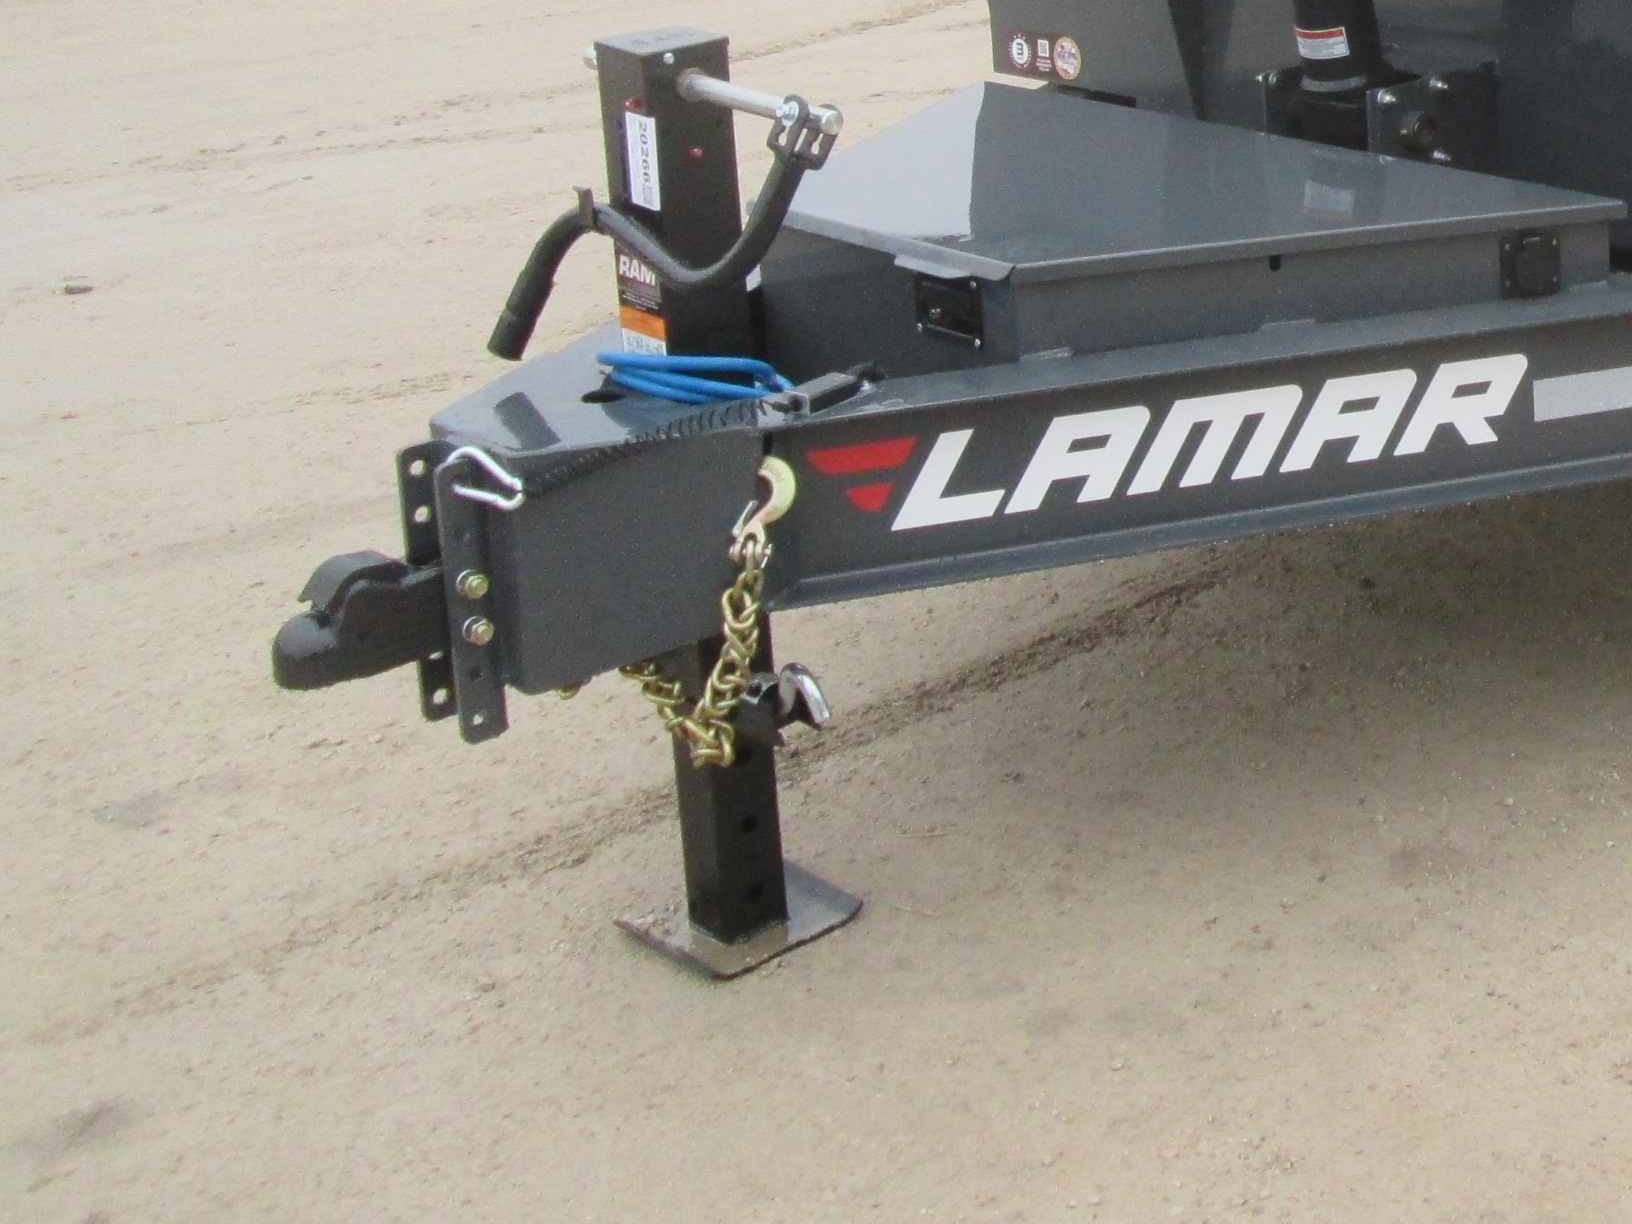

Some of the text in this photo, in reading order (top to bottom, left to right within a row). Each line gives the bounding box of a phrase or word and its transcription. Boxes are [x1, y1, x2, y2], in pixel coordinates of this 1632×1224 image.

[639, 119, 652, 184] 20266
[619, 254, 657, 287] RAM
[891, 353, 1528, 531] LAMAR
